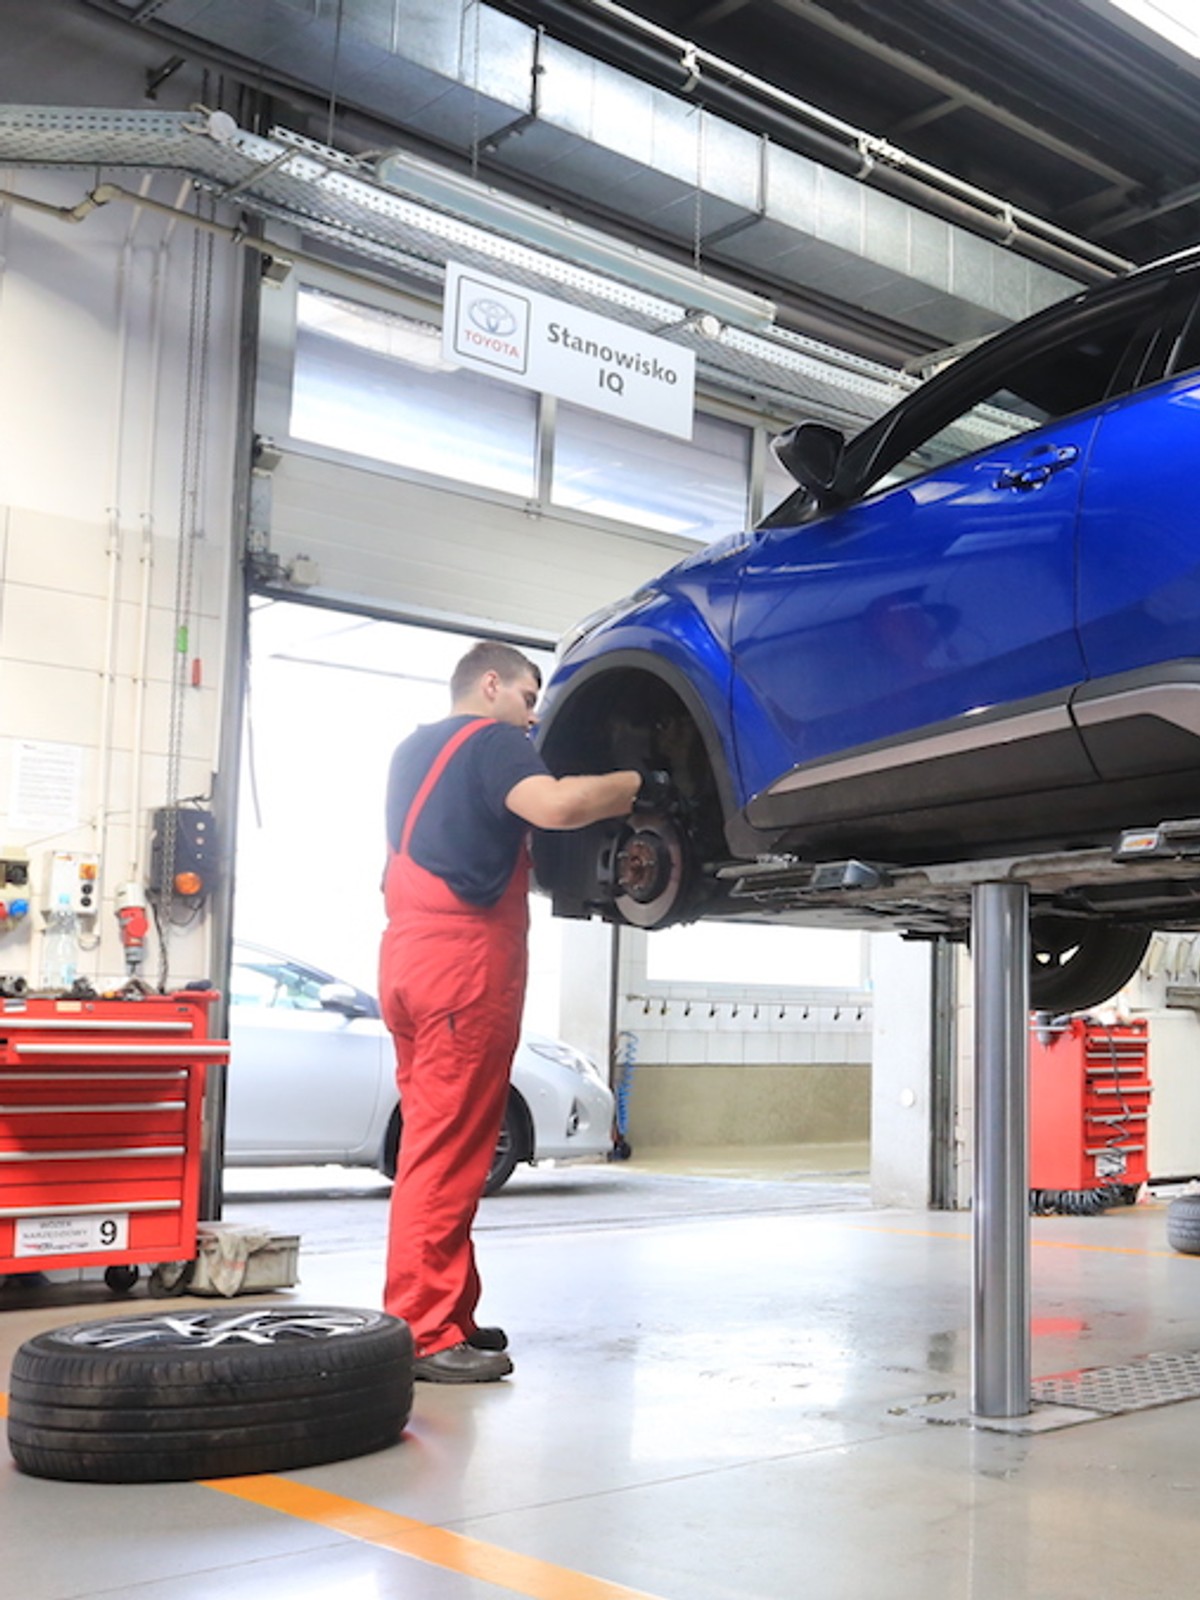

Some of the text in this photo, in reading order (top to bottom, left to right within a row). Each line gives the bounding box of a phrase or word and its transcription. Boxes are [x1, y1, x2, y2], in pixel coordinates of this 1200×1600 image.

[465, 329, 519, 358] TOYOTA
[547, 322, 678, 386] Stanowisko
[598, 369, 625, 396] IQ
[100, 1219, 118, 1246] 9
